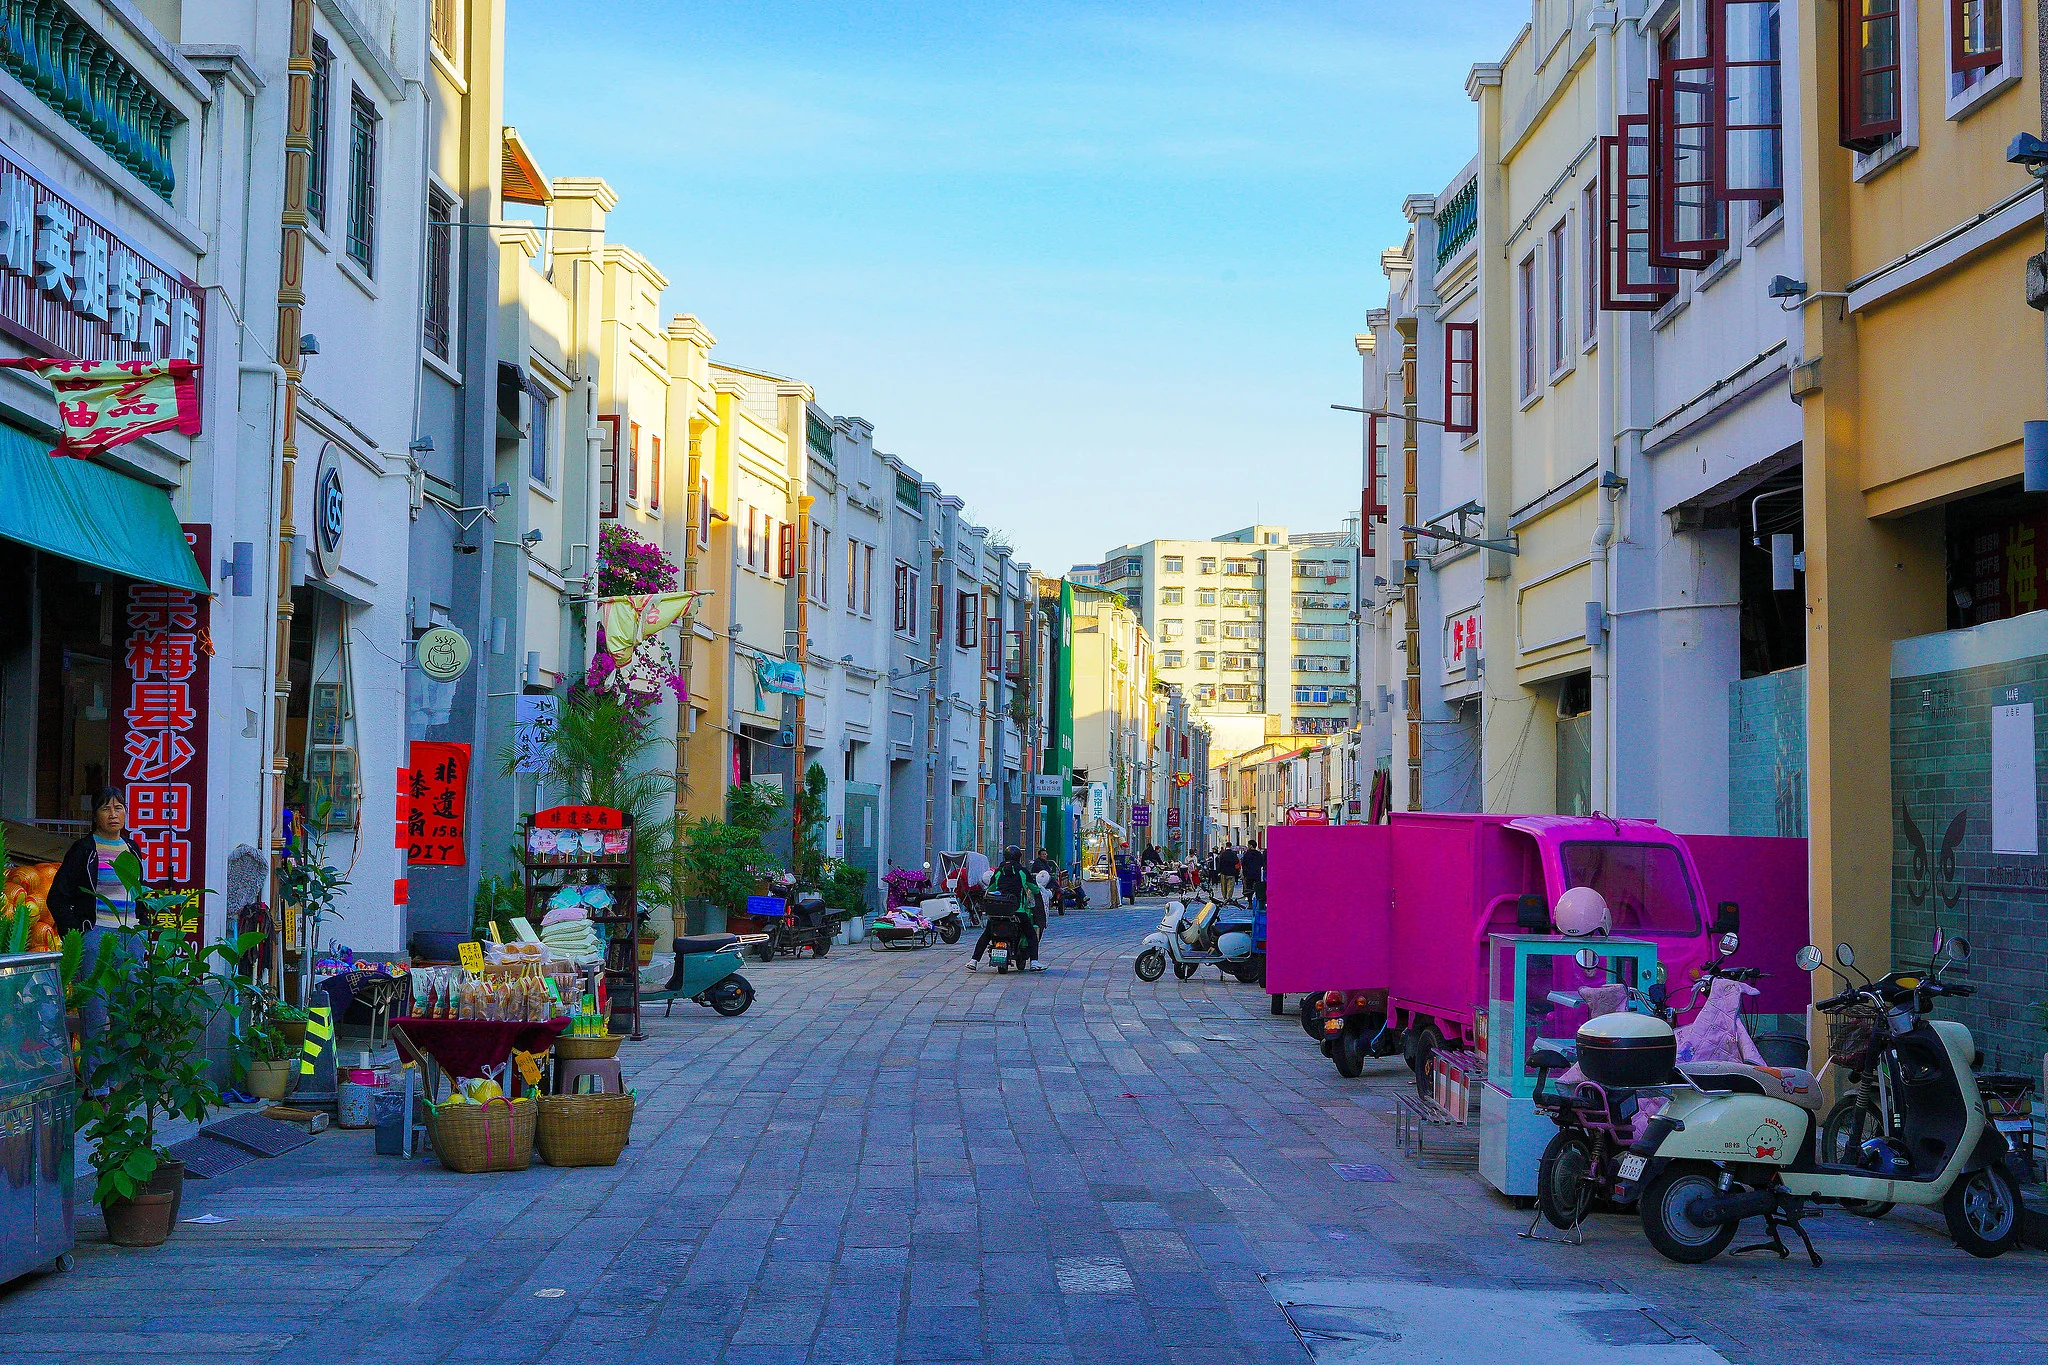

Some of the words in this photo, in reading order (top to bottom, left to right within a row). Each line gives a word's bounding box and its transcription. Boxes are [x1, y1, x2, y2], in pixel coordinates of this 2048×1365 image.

[2006, 522, 2048, 616] 梅
[124, 532, 198, 882] 宗梅县沙田柚
[407, 843, 455, 861] DIY
